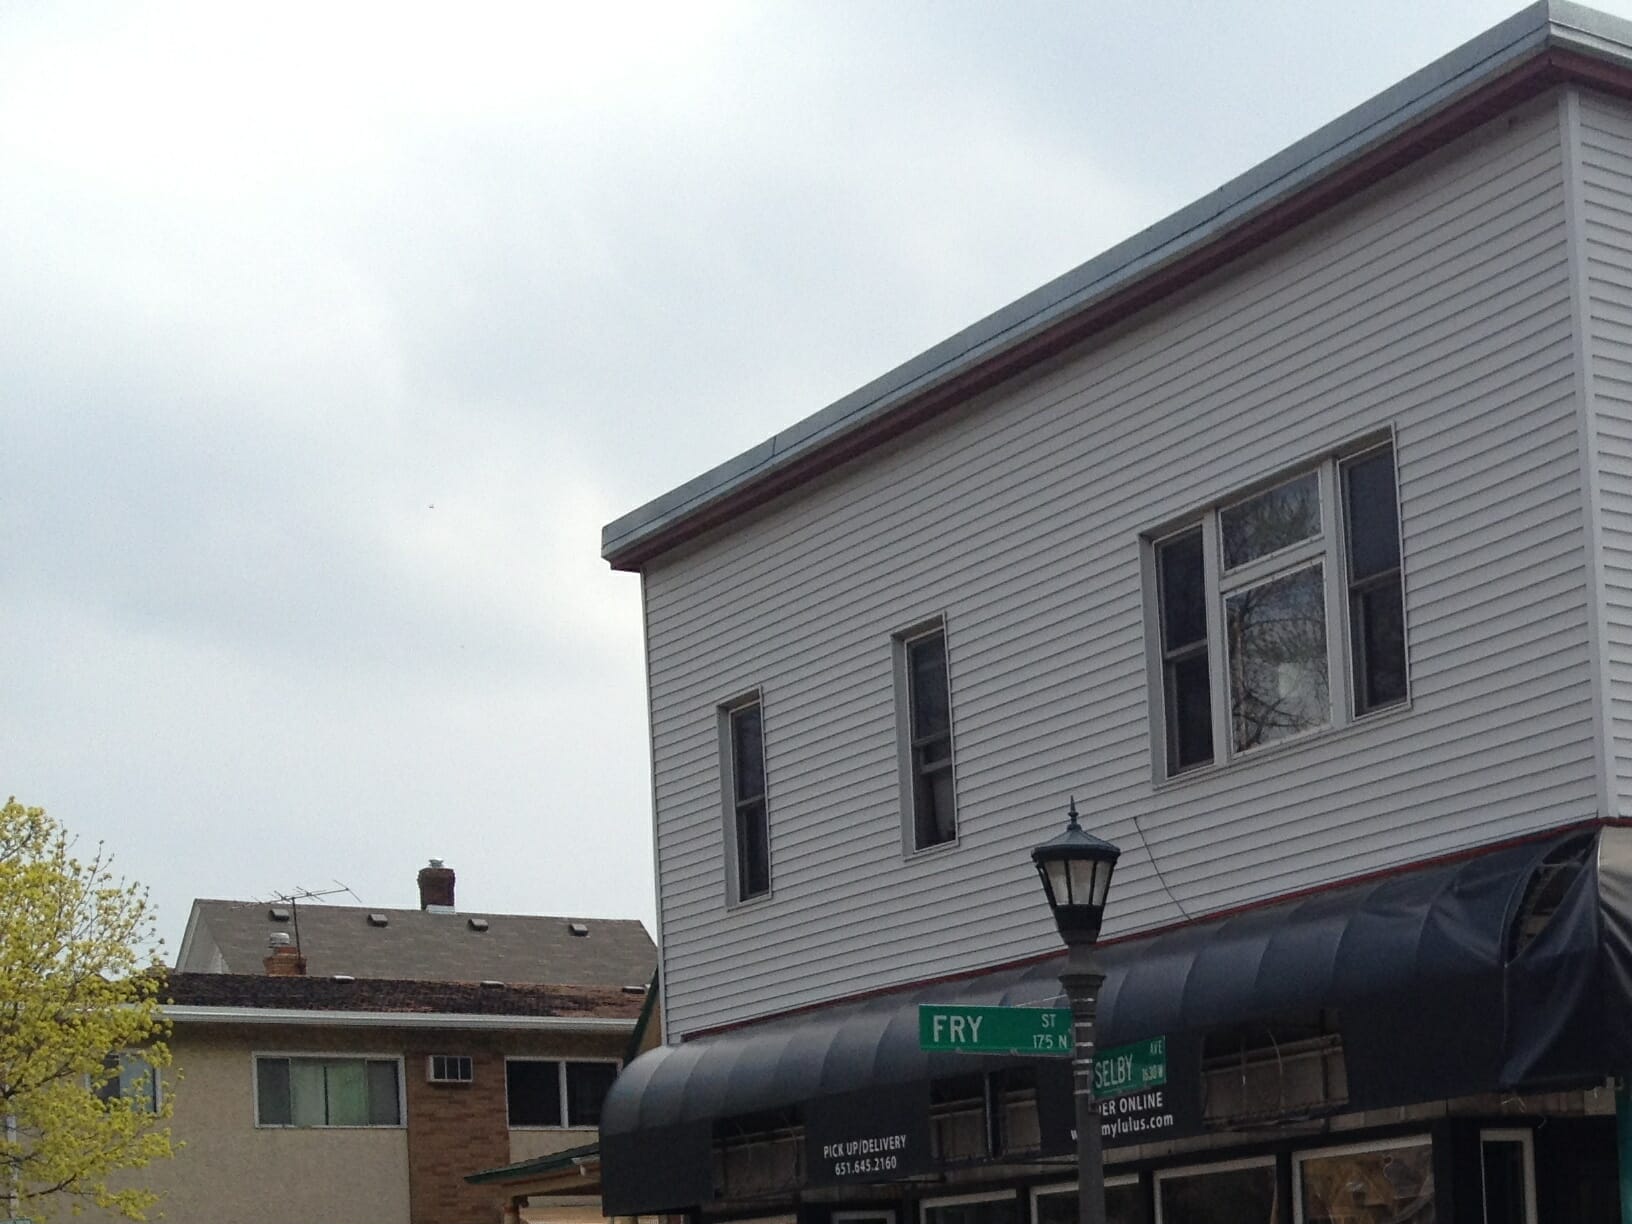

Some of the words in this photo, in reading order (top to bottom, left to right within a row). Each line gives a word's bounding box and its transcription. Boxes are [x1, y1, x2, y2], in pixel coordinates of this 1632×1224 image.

[932, 1014, 983, 1043] FRY
[1041, 1013, 1057, 1028] ST
[1032, 1034, 1053, 1050] 175
[1058, 1034, 1067, 1049] N
[1150, 1039, 1162, 1054] AVE
[1094, 1053, 1133, 1089] SELBY
[1119, 1091, 1163, 1114] ONLINE
[823, 1142, 845, 1159] PICK
[846, 1134, 907, 1156] UP/DELIVERY
[834, 1155, 897, 1176] 651.645.2160
